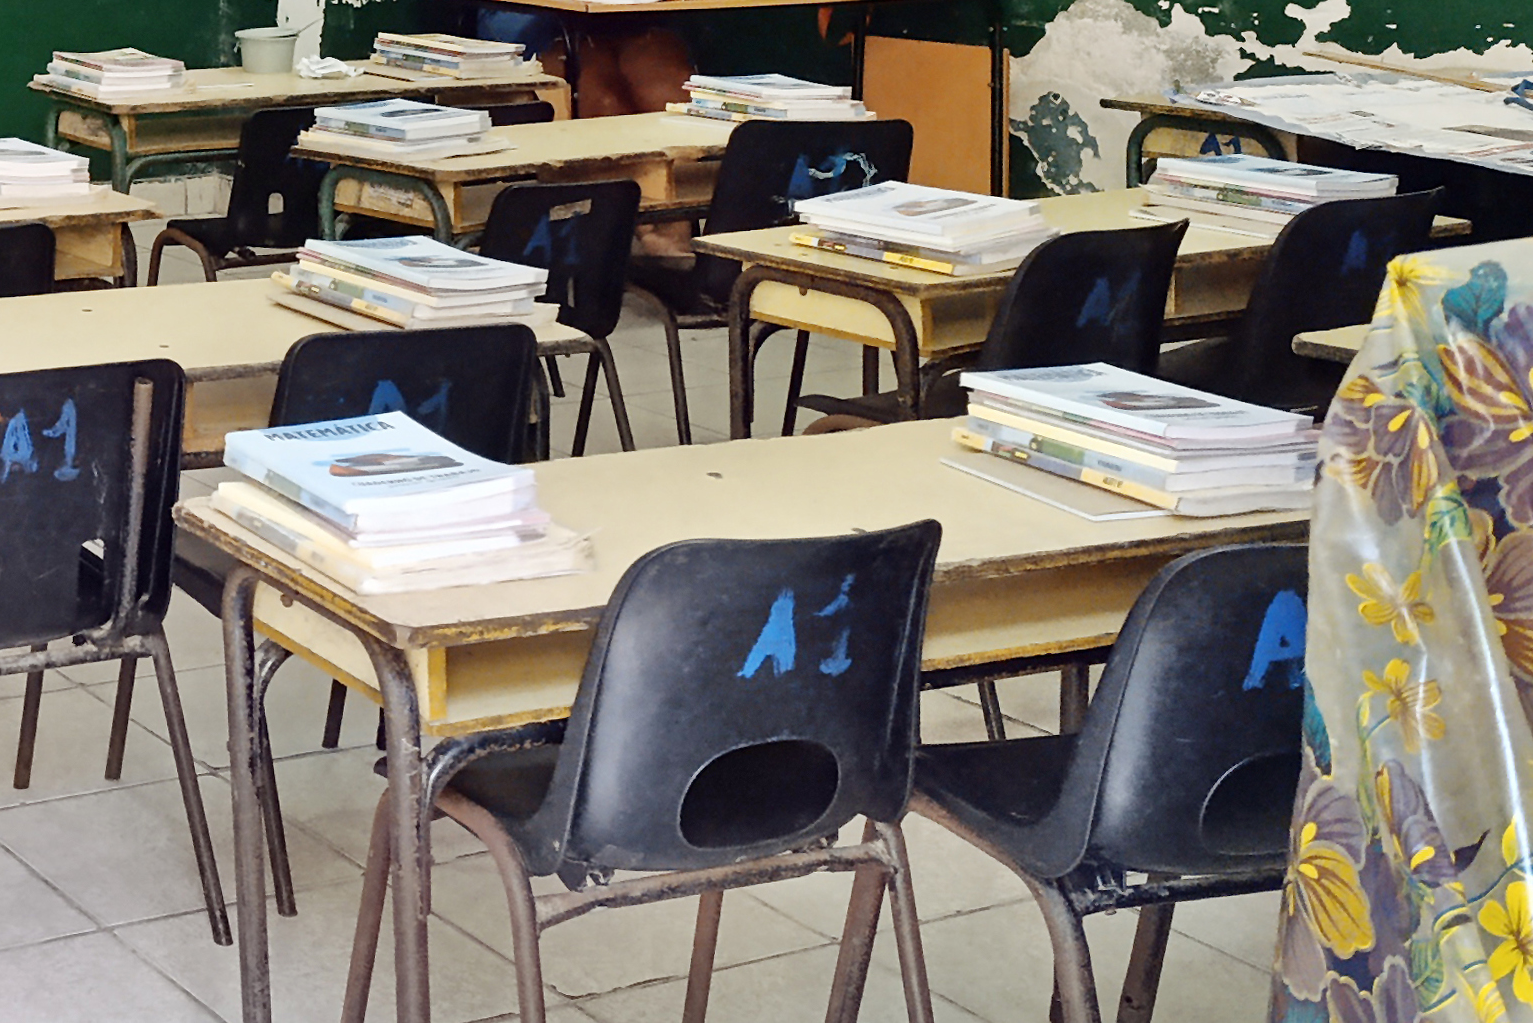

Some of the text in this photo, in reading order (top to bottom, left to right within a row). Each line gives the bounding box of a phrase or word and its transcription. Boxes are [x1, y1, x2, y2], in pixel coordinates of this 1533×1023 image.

[0, 397, 81, 484] A1
[264, 420, 396, 442] MATEMÁTICA
[736, 573, 856, 678] A1
